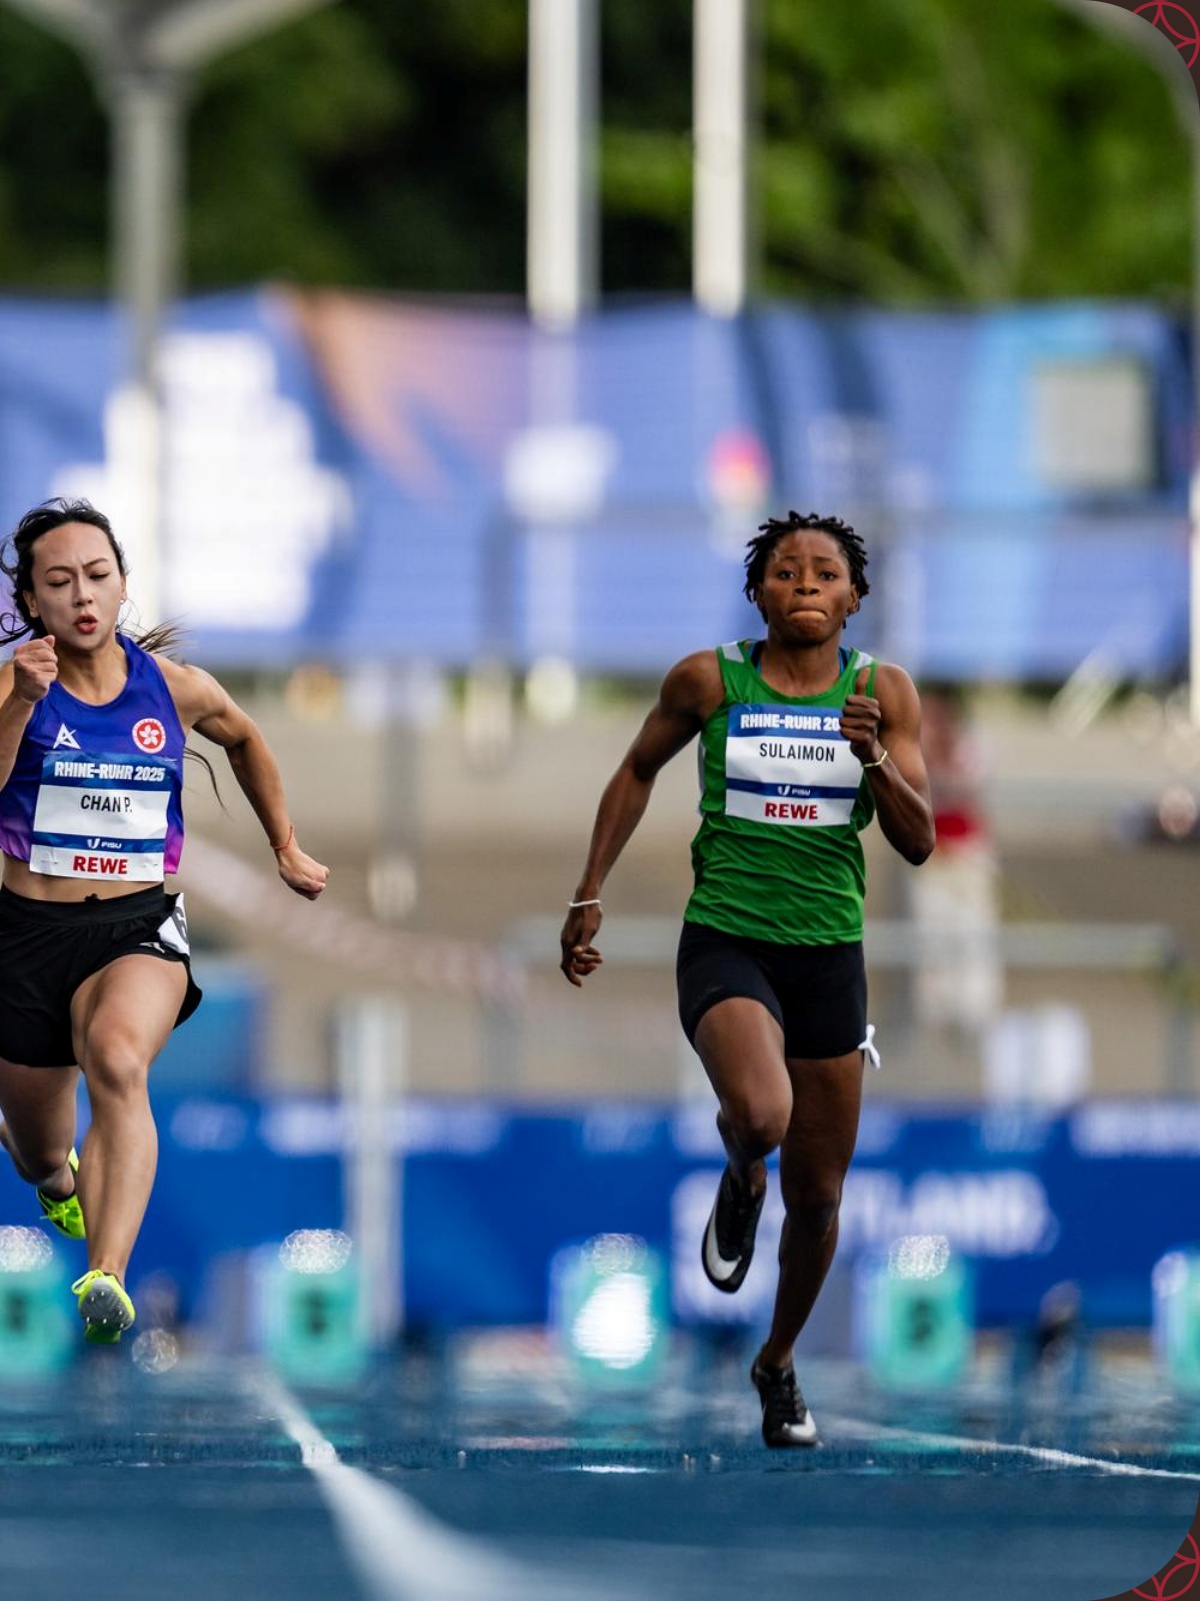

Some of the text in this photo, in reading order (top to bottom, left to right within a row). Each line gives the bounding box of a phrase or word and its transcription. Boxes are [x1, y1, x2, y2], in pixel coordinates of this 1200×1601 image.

[740, 713, 822, 731] RHINE-RUHR
[759, 742, 836, 762] SULAIMON
[54, 761, 166, 782] RHINE-RUHR 2025
[80, 795, 133, 813] CHAN P.
[764, 802, 818, 820] REWE
[73, 856, 128, 875] REWE
